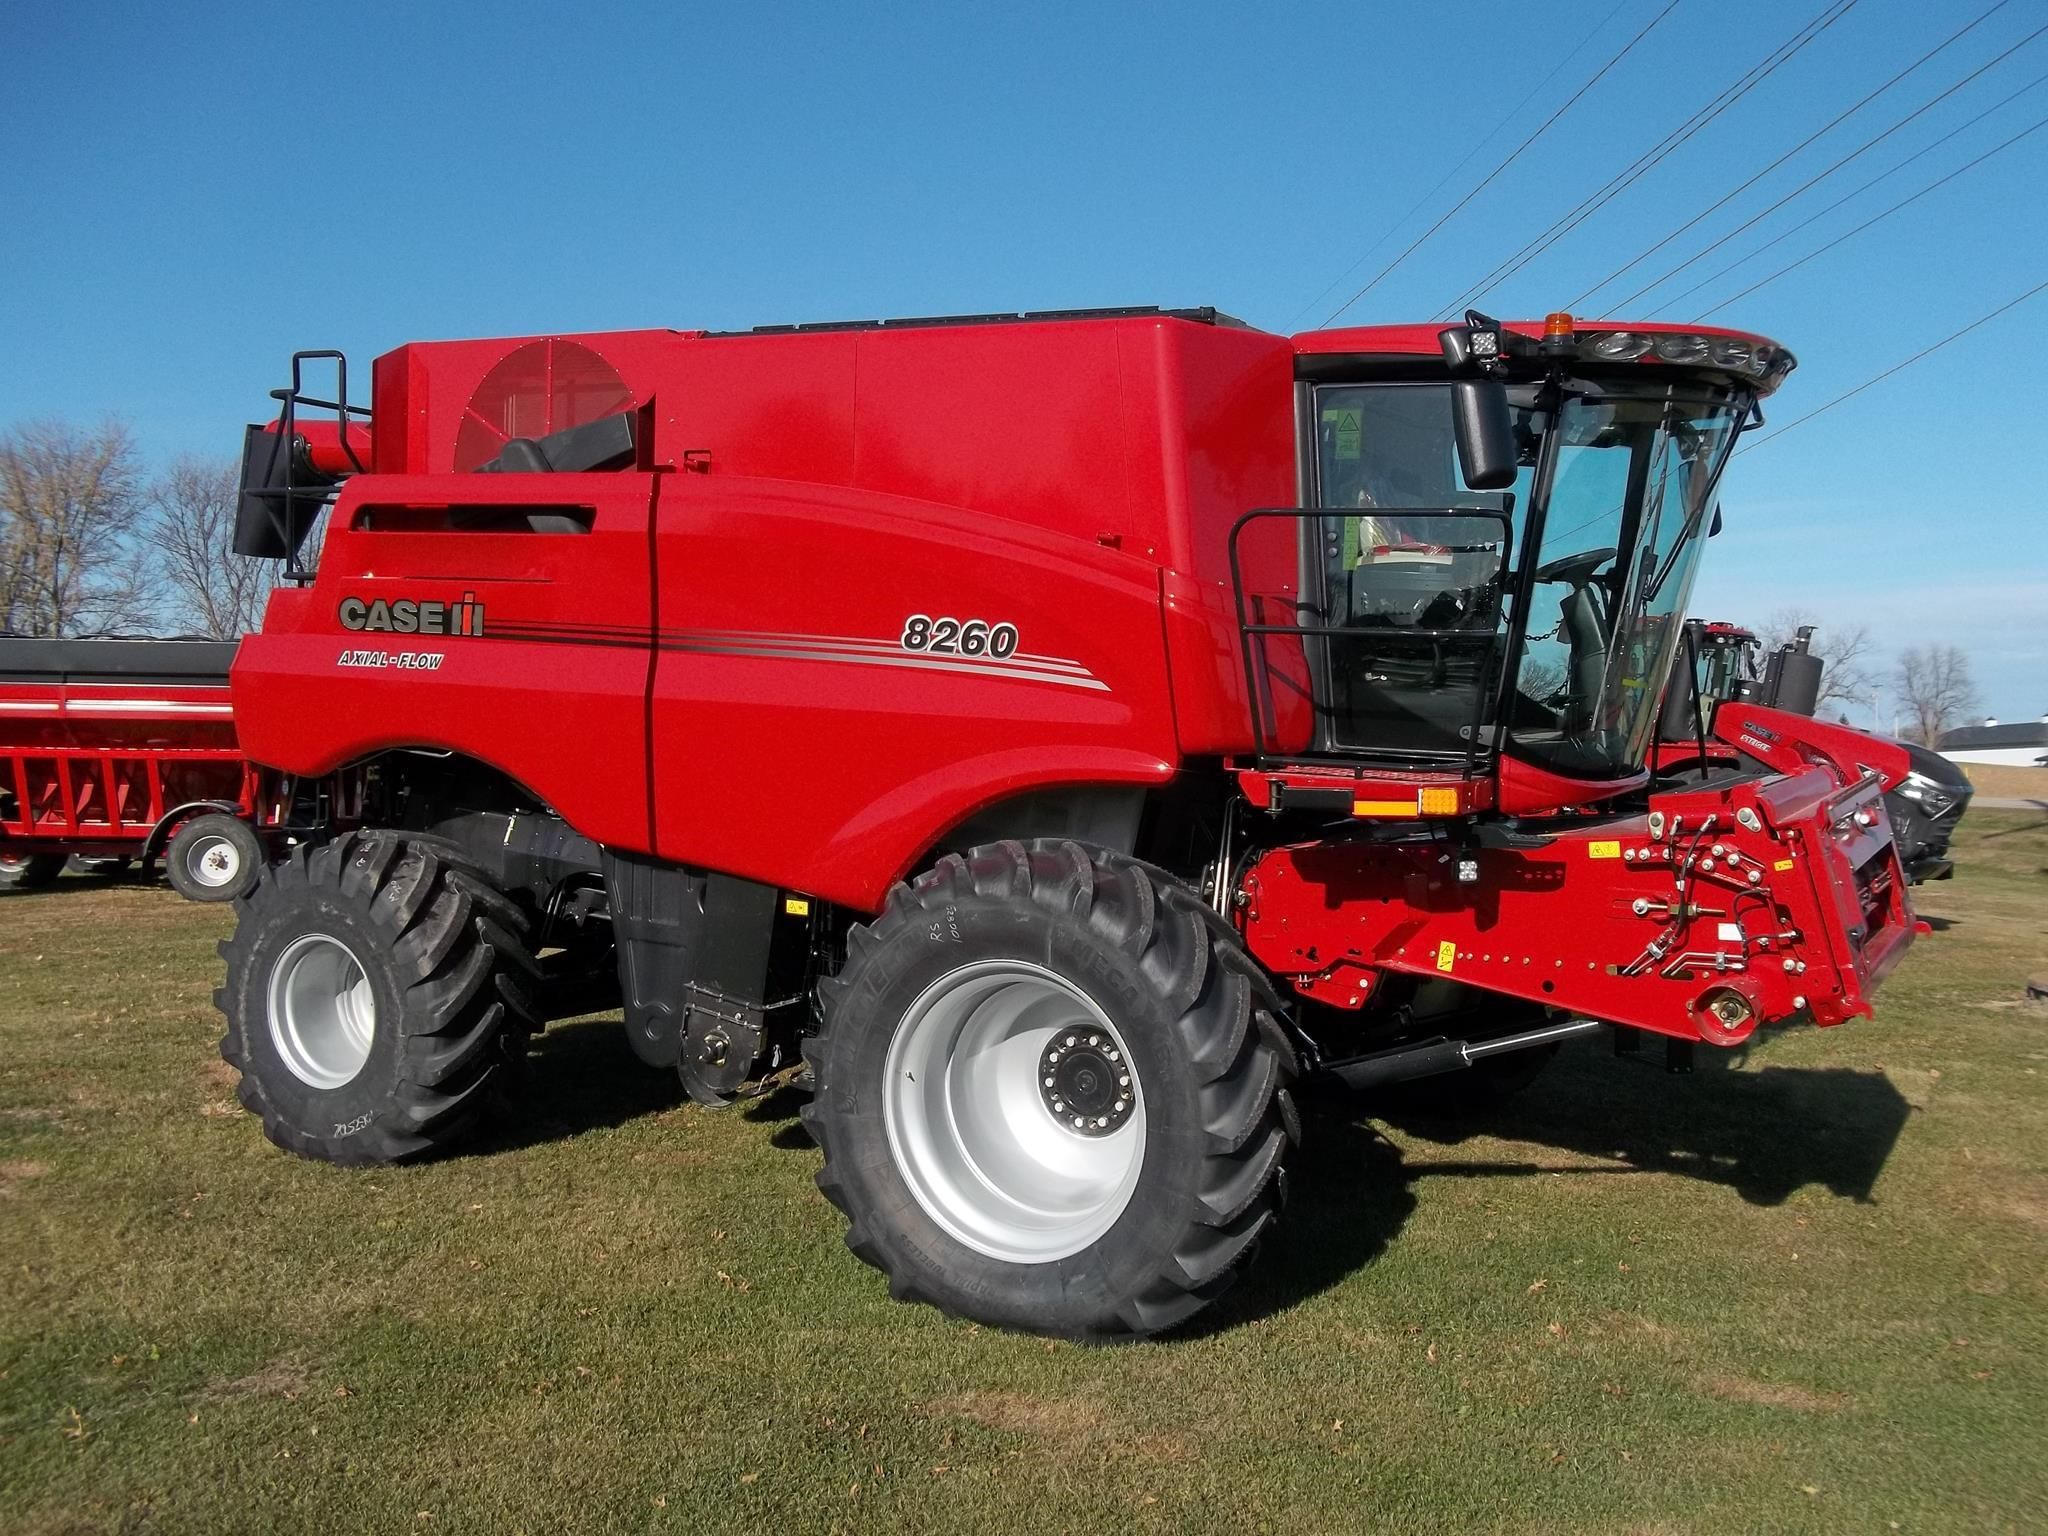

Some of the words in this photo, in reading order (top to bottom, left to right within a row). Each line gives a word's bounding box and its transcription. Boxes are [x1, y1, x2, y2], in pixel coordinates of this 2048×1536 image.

[339, 597, 445, 634] CASE
[902, 614, 1018, 659] 8260
[338, 650, 444, 670] AXIAL-FLOW
[930, 922, 945, 943] RS
